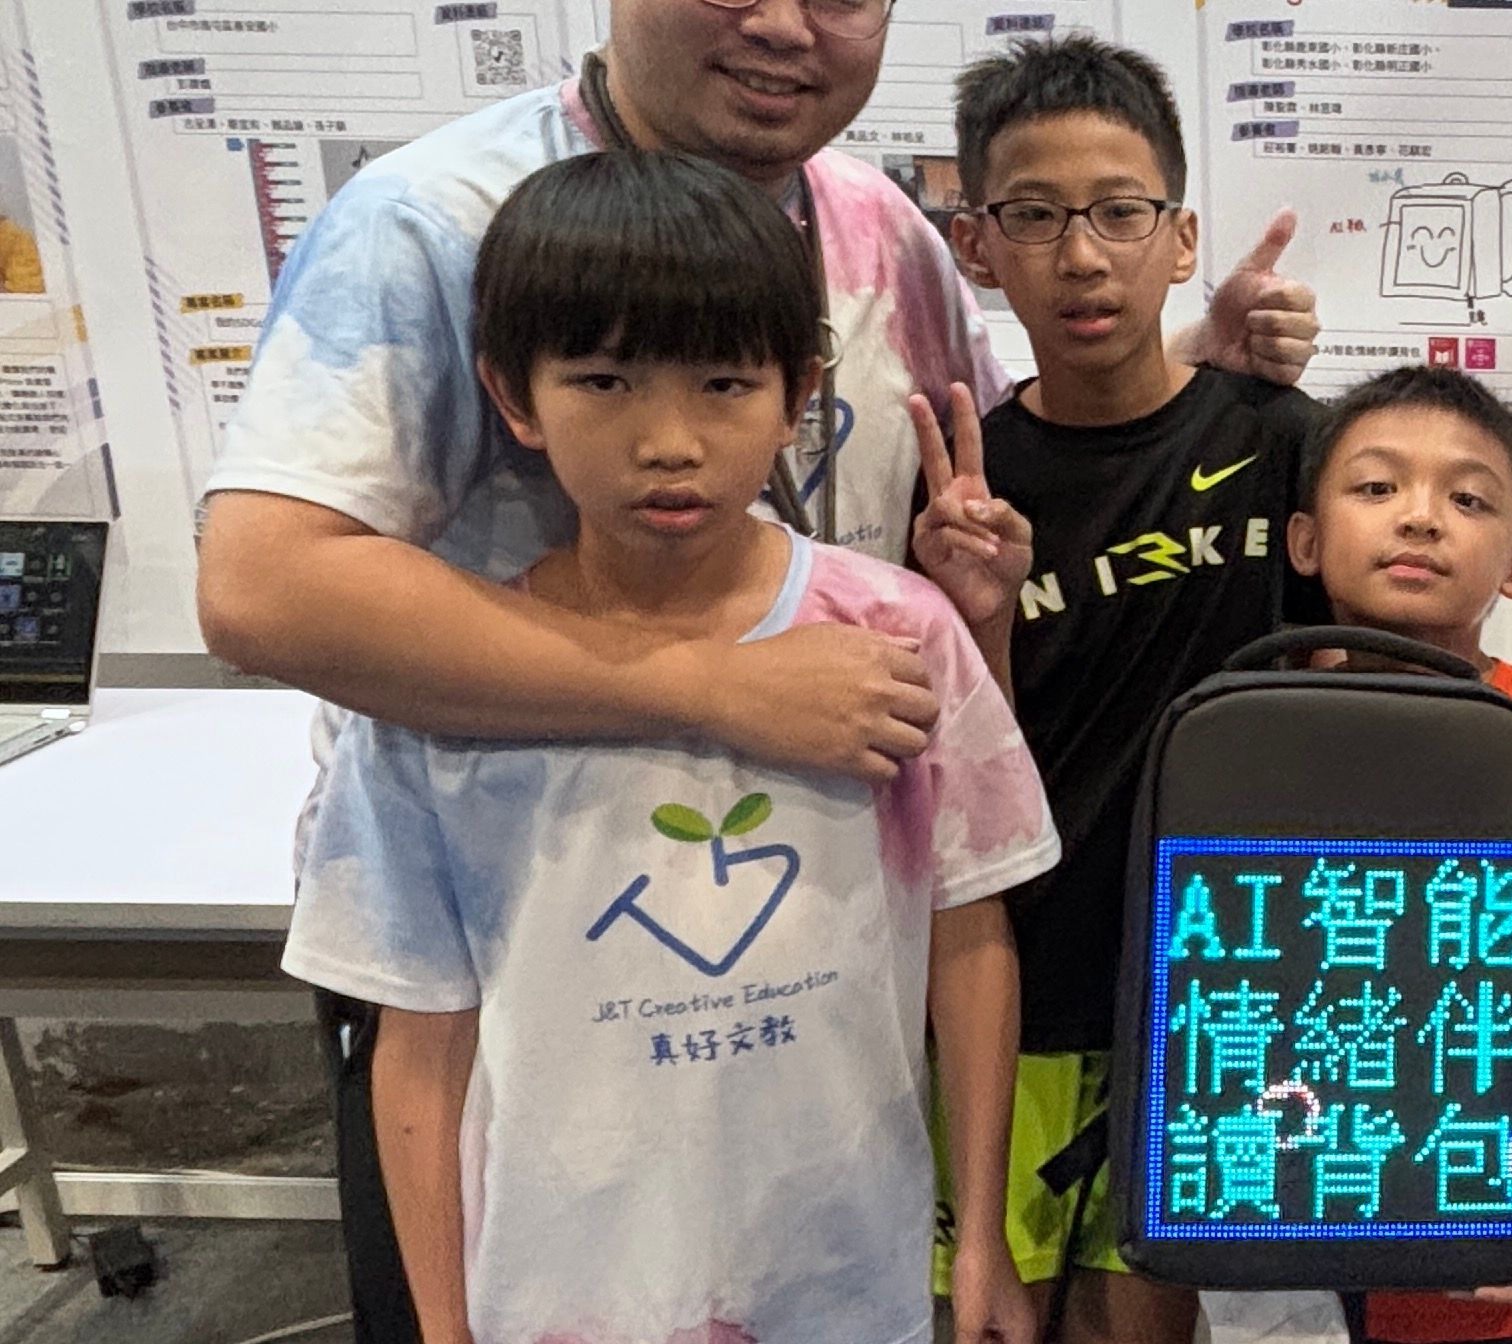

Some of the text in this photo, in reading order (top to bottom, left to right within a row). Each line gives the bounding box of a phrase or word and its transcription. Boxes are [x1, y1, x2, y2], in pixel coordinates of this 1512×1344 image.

[592, 969, 839, 1023] J&T Creative Education
[649, 1014, 797, 1067] 真好文教
